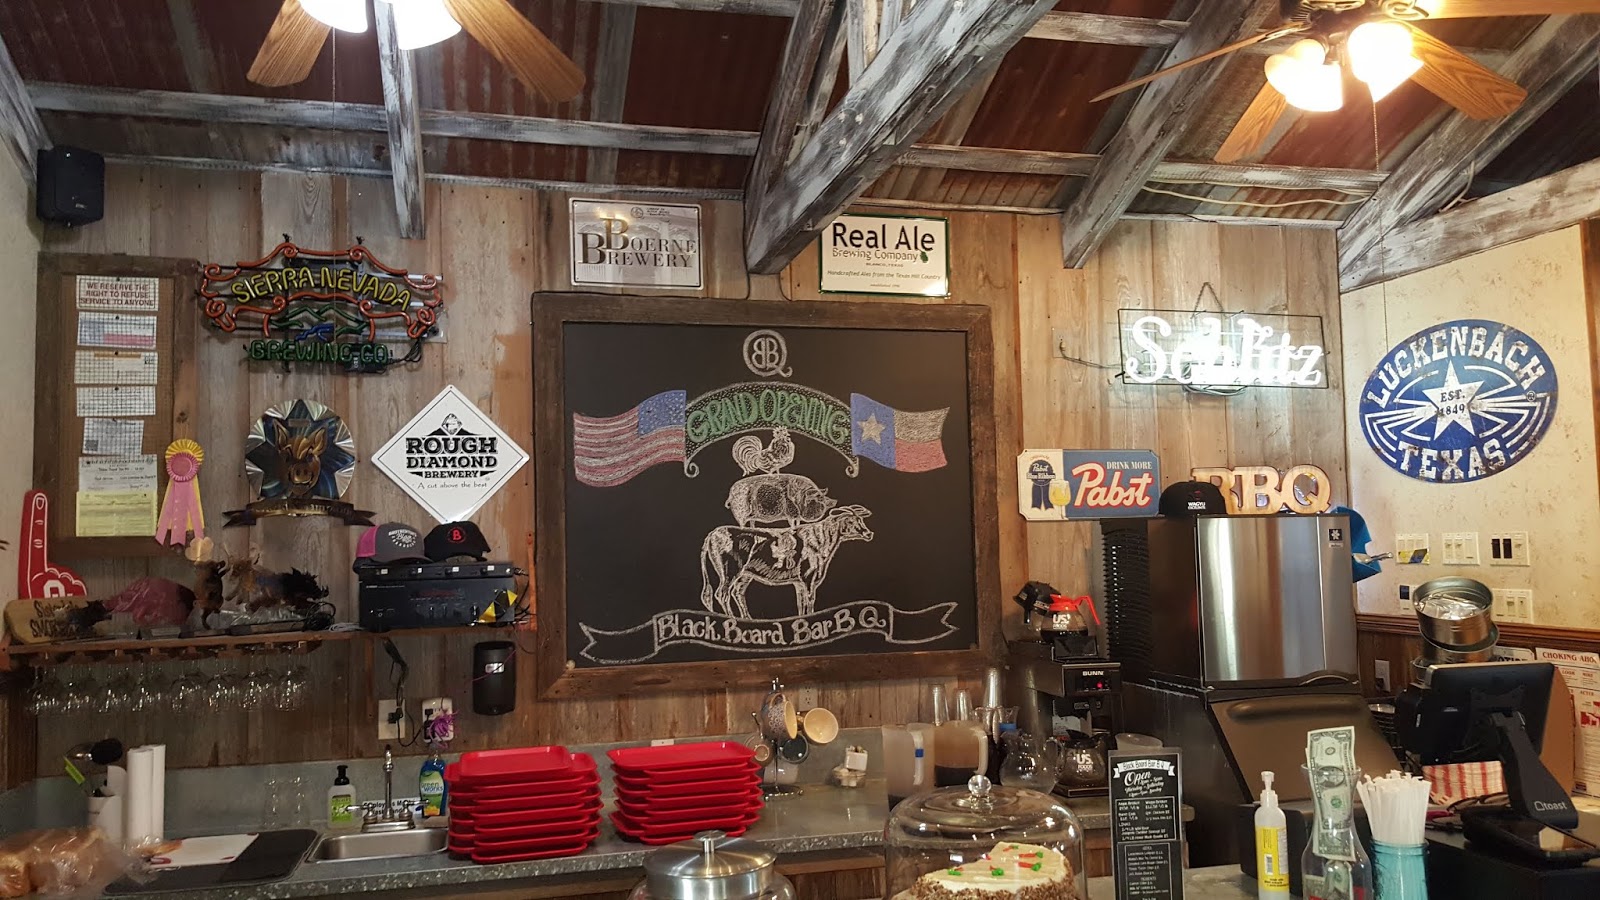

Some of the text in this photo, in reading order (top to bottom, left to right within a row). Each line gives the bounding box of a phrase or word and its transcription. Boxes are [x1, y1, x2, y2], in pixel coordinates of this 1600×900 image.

[600, 217, 697, 253] BOERNE
[833, 222, 935, 252] Real Ale
[577, 232, 692, 268] BREWERY
[832, 247, 919, 263] Brewing Company
[100, 282, 134, 290] RESERVE
[231, 266, 412, 312] SIERRA NEVADA
[121, 291, 149, 299] REFUSE
[250, 339, 353, 363] BREWING
[1125, 316, 1323, 385] Schlitz
[1367, 325, 1547, 409] LUCKENBACH
[1440, 388, 1466, 403] EST.
[687, 388, 850, 445] GRAND OPENING
[1440, 404, 1465, 417] 1849
[406, 436, 497, 454] ROUGH
[406, 455, 498, 469] DIAMOND
[1106, 461, 1153, 470] DRINK MORE
[1398, 438, 1507, 481] TEXAS
[424, 470, 480, 479] BREWERY
[1033, 463, 1048, 472] Pabst
[439, 481, 459, 489] above
[1072, 462, 1154, 507] Pabst
[452, 529, 462, 541] B
[658, 614, 721, 642] Black
[722, 617, 787, 645] Board
[1542, 651, 1577, 662] CHOKING
[1124, 771, 1151, 786] Open
[1545, 801, 1567, 811] toast
